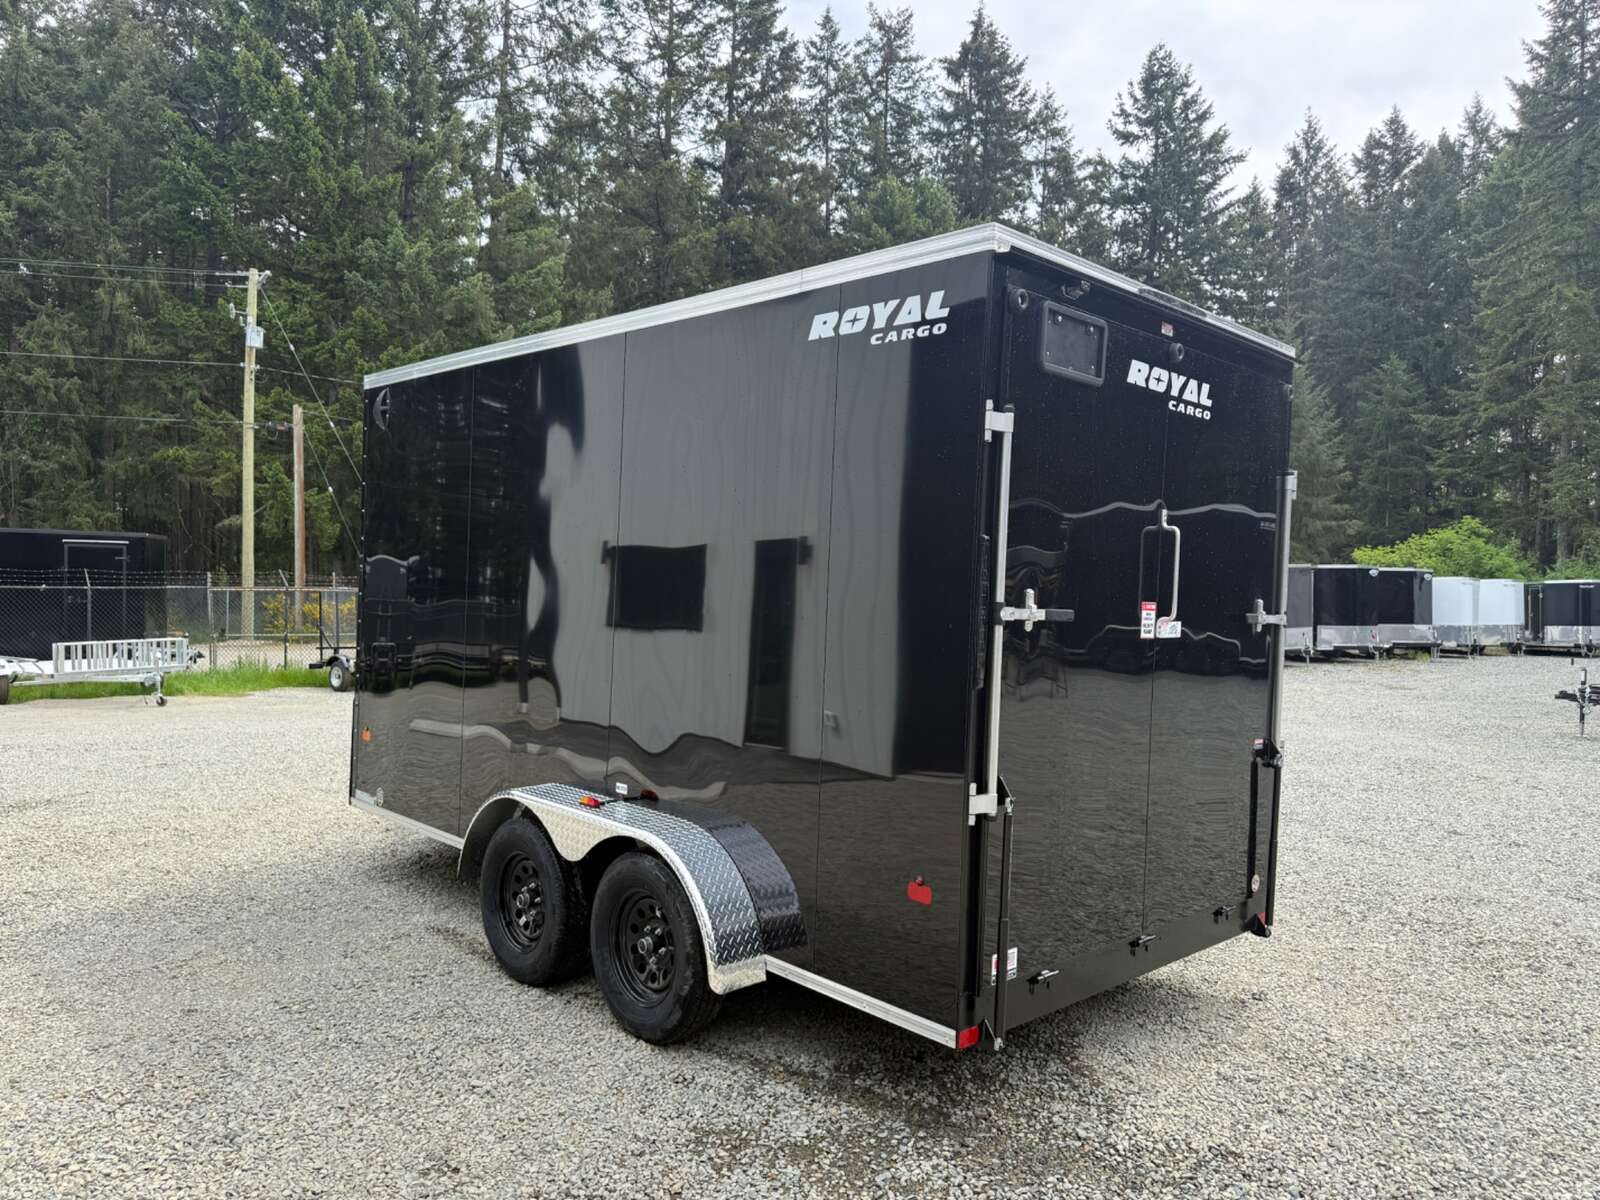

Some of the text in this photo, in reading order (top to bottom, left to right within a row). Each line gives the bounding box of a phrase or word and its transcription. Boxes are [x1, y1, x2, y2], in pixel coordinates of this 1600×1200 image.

[808, 290, 950, 341] ROYAL
[870, 323, 947, 345] CARGO
[1126, 359, 1213, 407] ROYAL
[1168, 400, 1211, 420] CARGO
